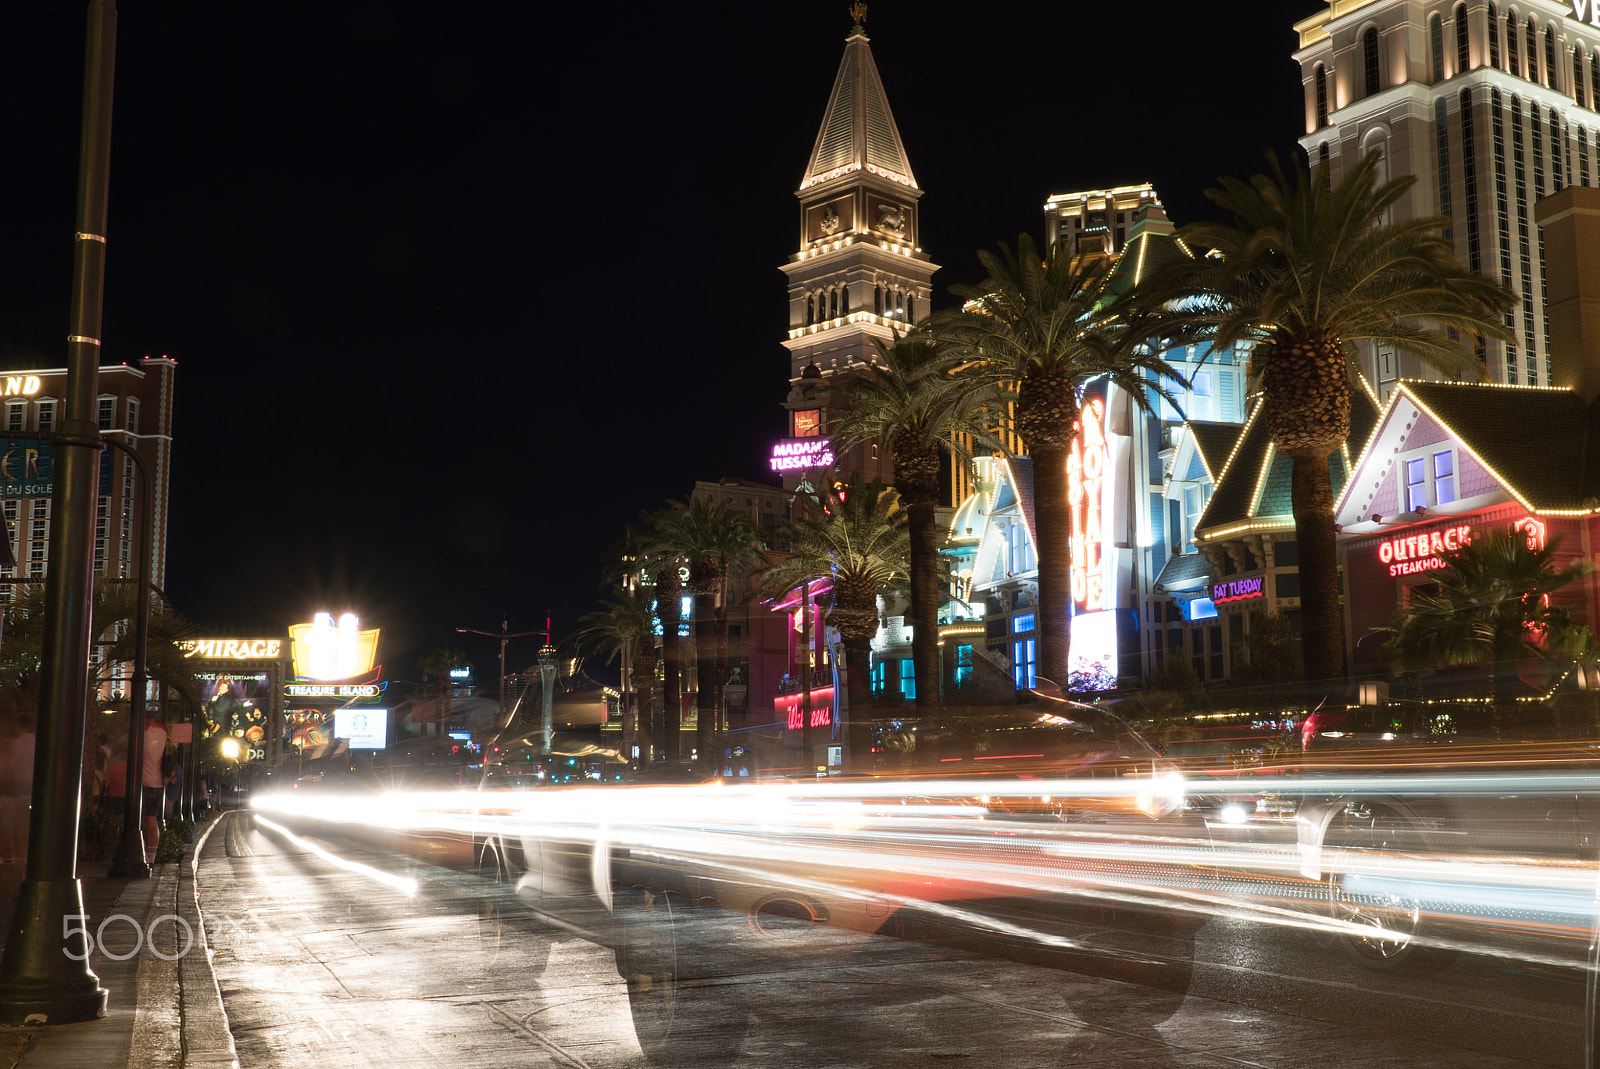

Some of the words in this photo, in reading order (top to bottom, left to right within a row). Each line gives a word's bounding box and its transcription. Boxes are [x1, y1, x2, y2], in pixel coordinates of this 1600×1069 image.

[0, 376, 40, 396] ND
[1066, 421, 1088, 602] ASINO
[1081, 398, 1105, 611] ROYALE
[1379, 524, 1472, 564] OUTBACK
[1389, 556, 1447, 577] STEAKHOU
[1213, 588, 1227, 599] FAT
[1228, 577, 1262, 596] TUESDAY
[184, 639, 281, 659] MIRAGE
[289, 686, 335, 695] TREASURE
[339, 686, 374, 695] ISLAND
[787, 702, 831, 730] Waleens
